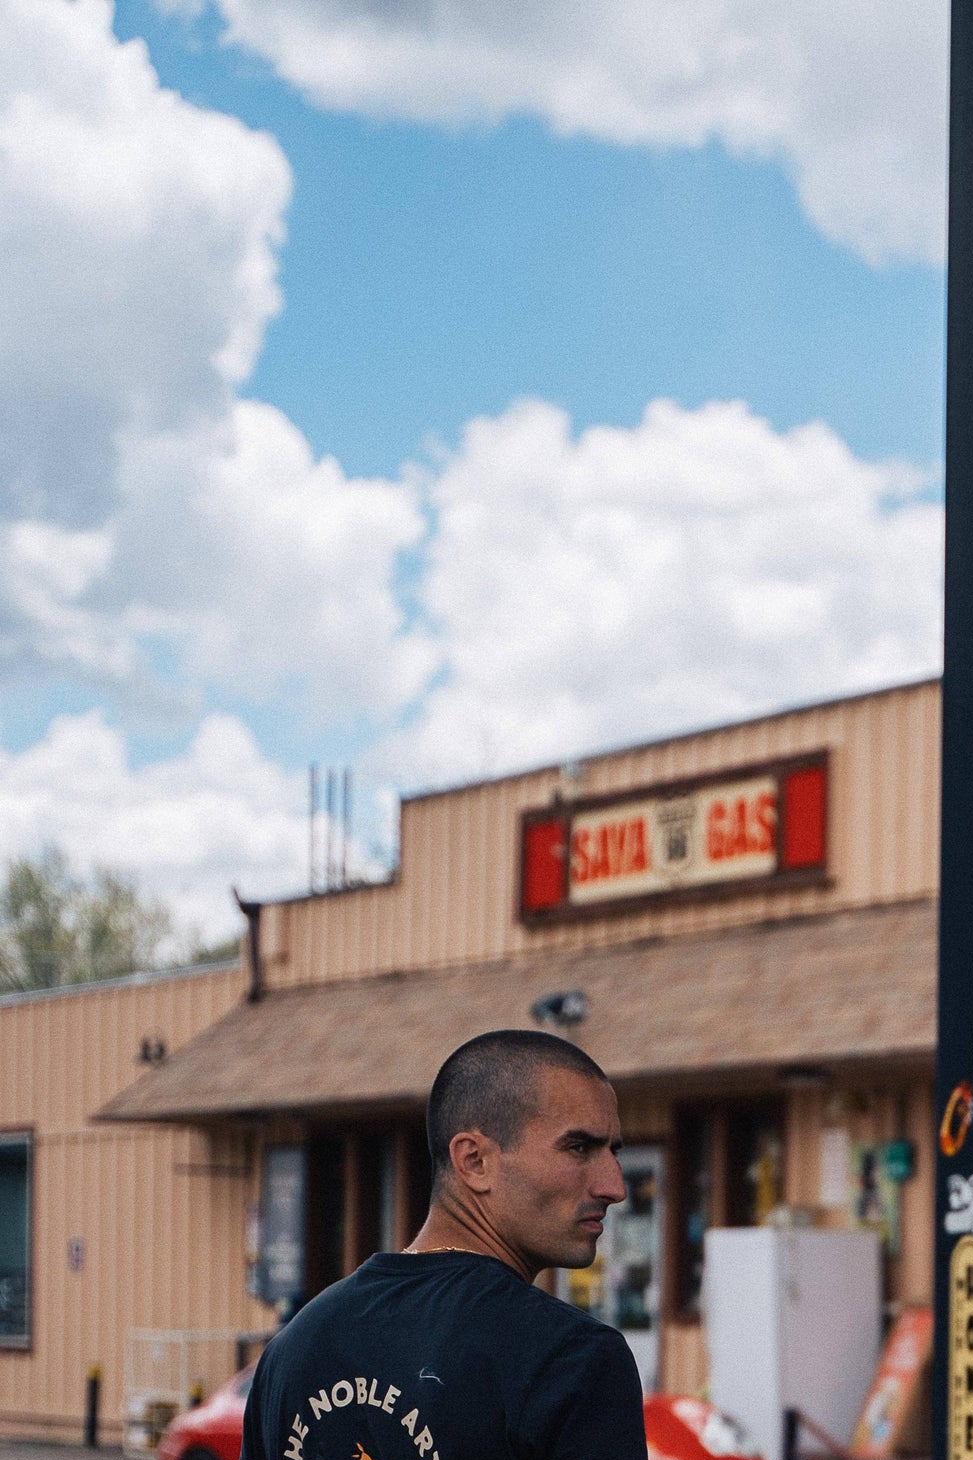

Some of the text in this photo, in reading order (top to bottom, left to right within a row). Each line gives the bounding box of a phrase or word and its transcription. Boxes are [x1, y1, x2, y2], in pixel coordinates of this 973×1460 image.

[572, 815, 648, 885] SAYA
[706, 792, 777, 864] GAS
[308, 1377, 402, 1421] NOBLE
